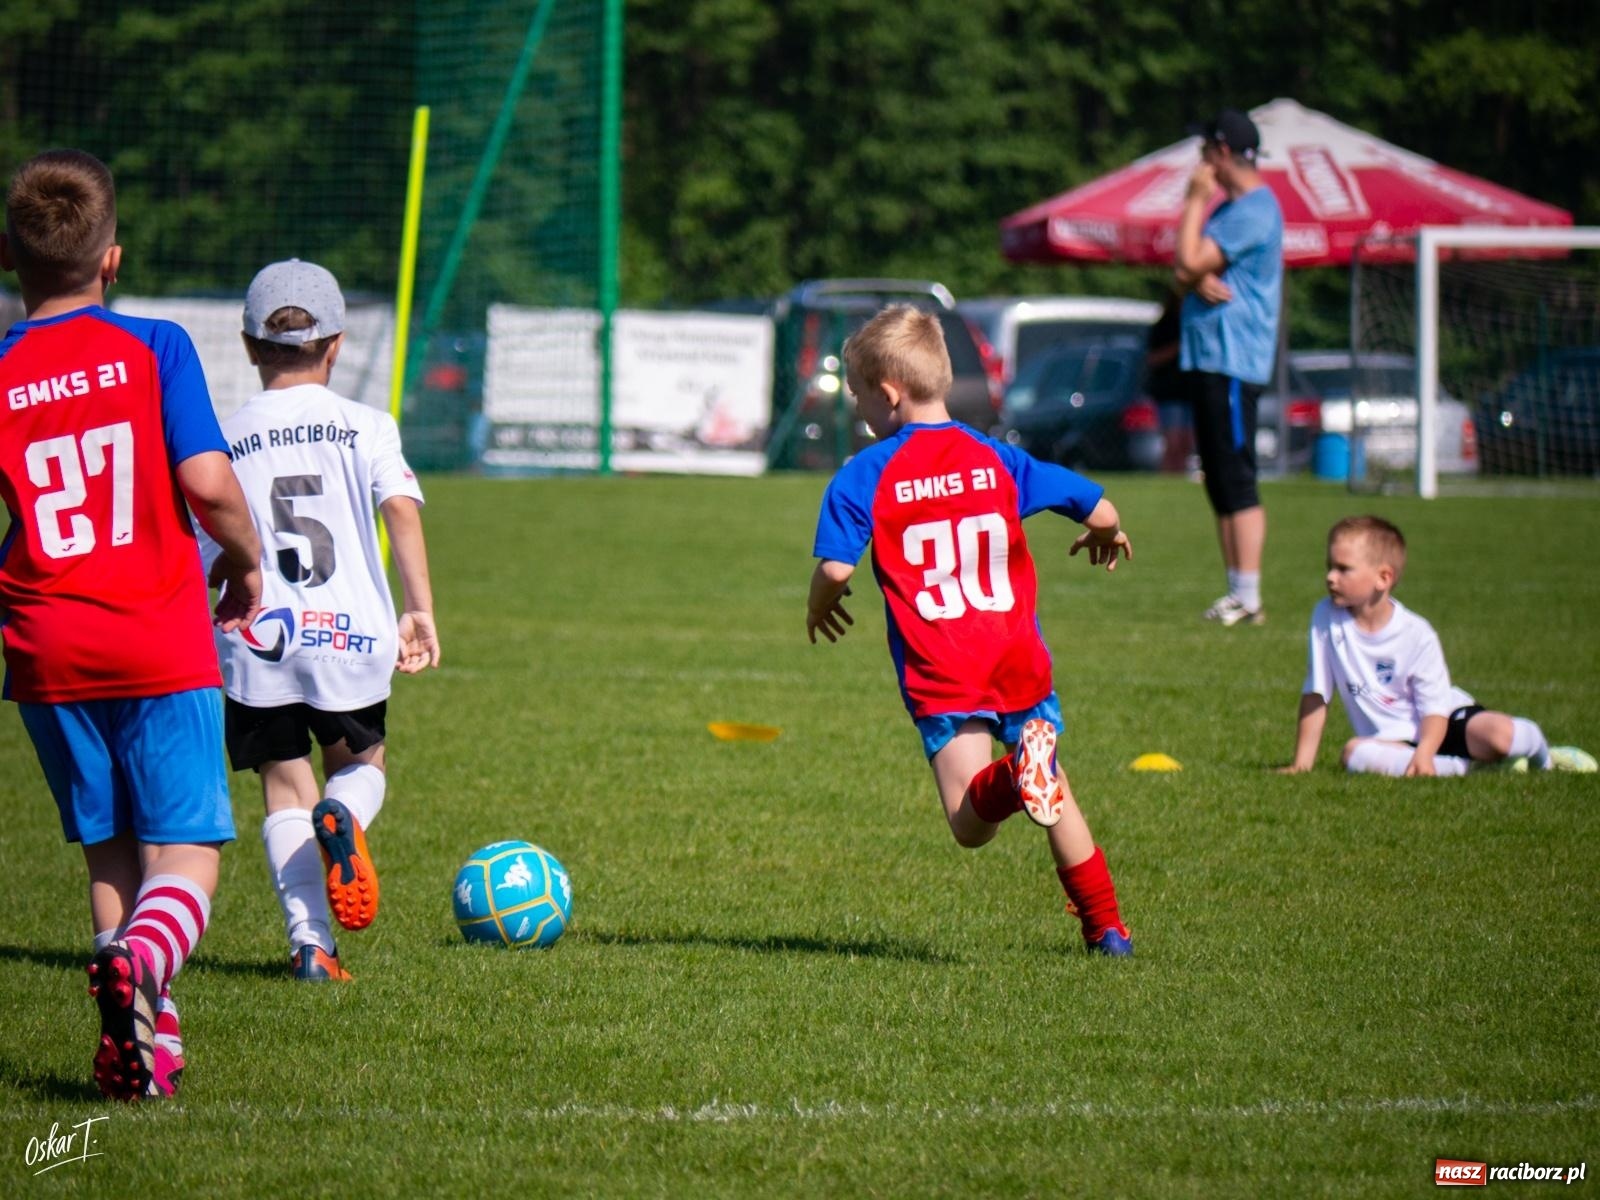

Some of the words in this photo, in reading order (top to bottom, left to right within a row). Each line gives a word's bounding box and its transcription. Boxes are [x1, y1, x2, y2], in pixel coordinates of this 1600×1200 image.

[8, 371, 90, 411] GMKS
[97, 361, 128, 388] 21
[268, 420, 359, 449] RACIBÓRZ
[25, 421, 134, 559] 27
[894, 472, 964, 503] GMKS
[971, 467, 997, 491] 21
[270, 474, 336, 588] 5
[902, 512, 1015, 621] 30
[301, 611, 350, 631] PRO
[300, 630, 377, 653] SPORT
[313, 655, 355, 666] ACTIVE
